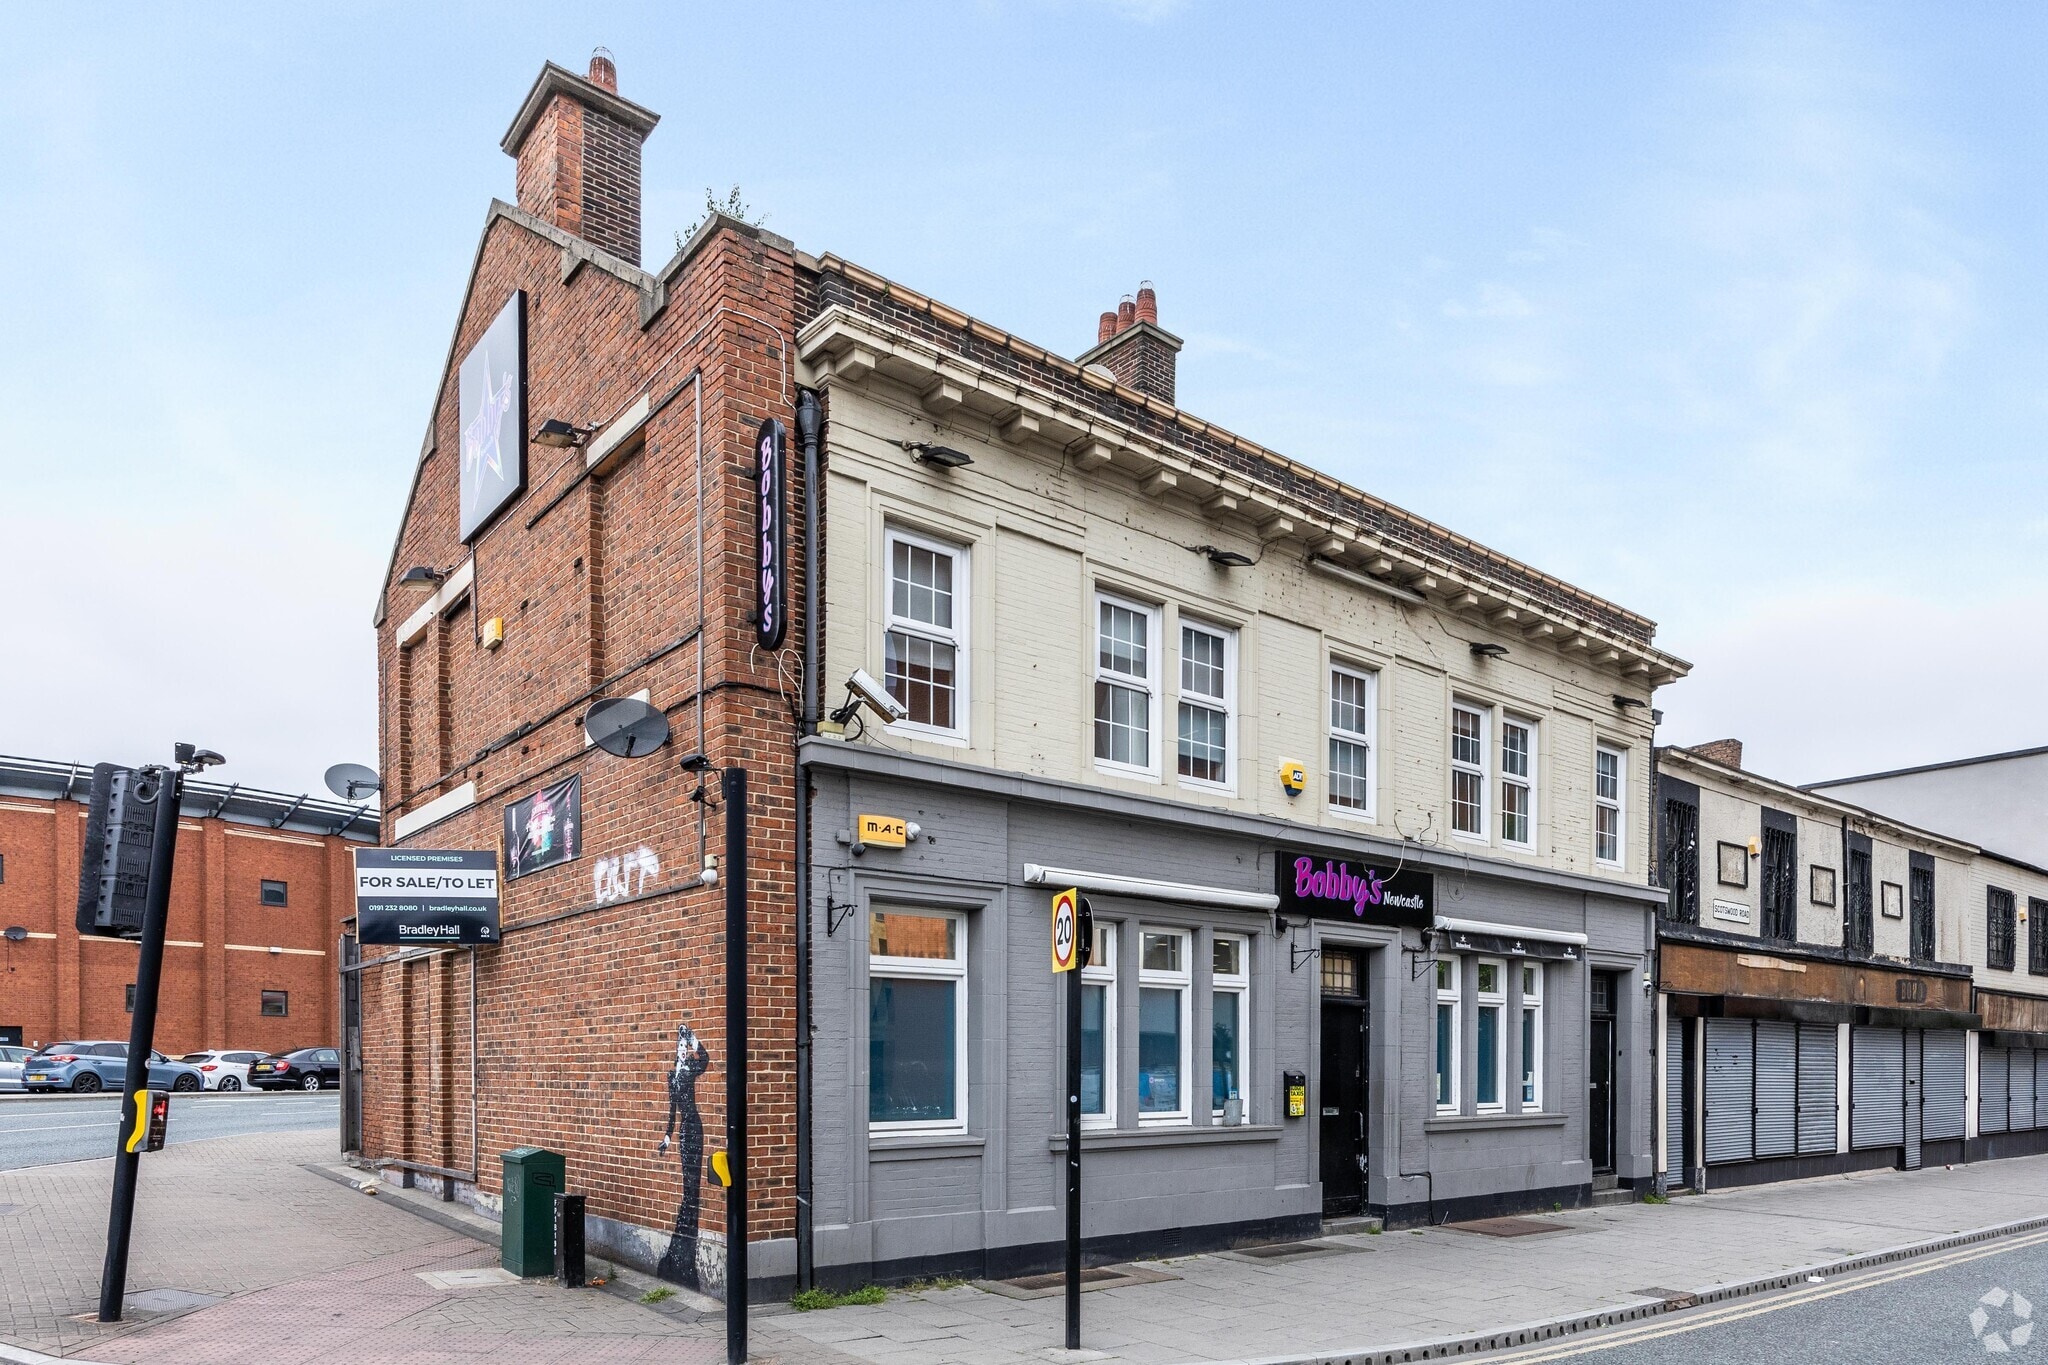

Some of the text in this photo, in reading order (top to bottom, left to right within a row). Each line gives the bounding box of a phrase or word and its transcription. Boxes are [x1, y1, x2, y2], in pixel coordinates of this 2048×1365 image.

[427, 855, 464, 863] PREMISES
[360, 876, 495, 890] FOR SALE/TO LET
[1294, 856, 1424, 917] Bobby's Newcastle
[429, 905, 488, 913] bradleyhall.co.uk
[1057, 915, 1072, 946] 20
